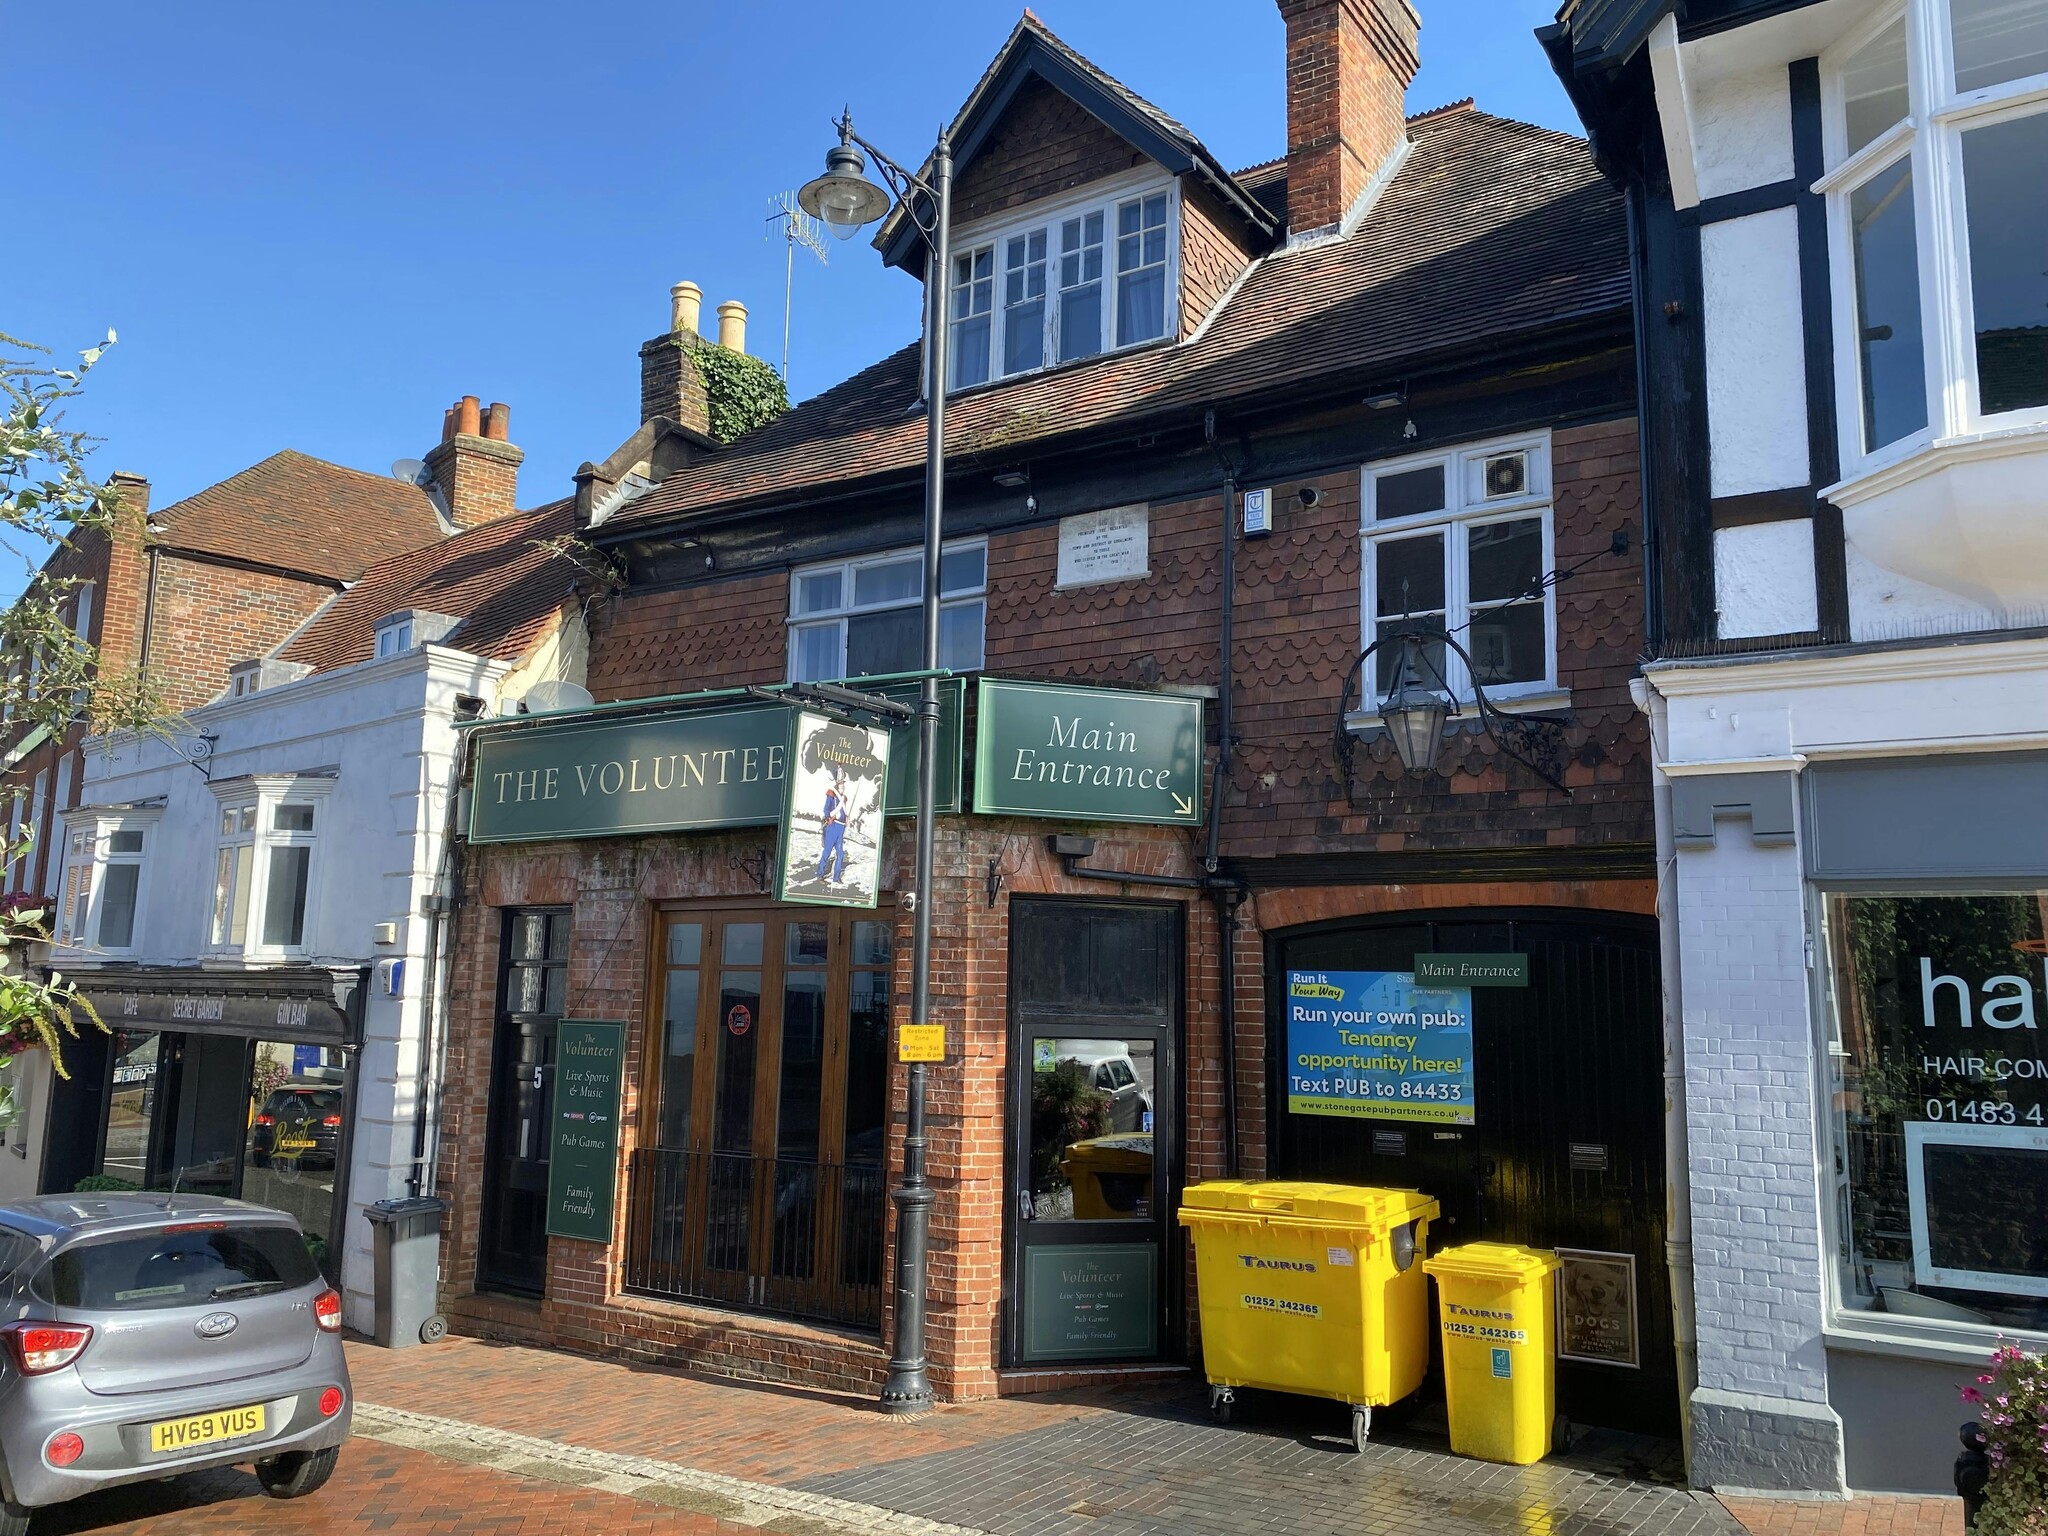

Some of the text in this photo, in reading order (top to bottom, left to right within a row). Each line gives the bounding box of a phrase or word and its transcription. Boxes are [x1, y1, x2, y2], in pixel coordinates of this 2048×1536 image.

[1046, 715, 1138, 753] Main
[838, 736, 852, 750] The
[816, 742, 872, 769] Volunteer
[493, 744, 785, 804] THE VOLUNTEE
[1010, 748, 1171, 790] Entrance
[1294, 973, 1328, 984] Run It
[1421, 963, 1521, 977] Main Entrance
[1294, 984, 1341, 1000] Your Way
[172, 998, 224, 1020] SECRET GARDEN
[276, 1003, 308, 1026] GIN BAR
[1293, 1006, 1466, 1030] Run your own pub:
[585, 1034, 596, 1043] The
[1338, 1029, 1417, 1052] Tenancy
[566, 1040, 614, 1056] Volunteer
[1297, 1053, 1462, 1076] opportunity here!
[1924, 1056, 1986, 1077] HAIR
[534, 1066, 542, 1089] 5
[566, 1070, 610, 1085] Live Sports
[570, 1084, 603, 1098] & Music
[1292, 1076, 1462, 1100] Text PUB to 84433
[1300, 1101, 1460, 1118] www.stonegatepubpartners.co.uk
[1926, 1098, 2044, 1126] 01483 4
[561, 1134, 605, 1149] Pub Games
[566, 1184, 593, 1202] Family
[562, 1200, 595, 1219] Friendly
[1086, 1262, 1099, 1271] The
[1062, 1270, 1122, 1283] Volunteer
[1060, 1292, 1072, 1300] Live
[1075, 1292, 1095, 1300] Sports
[1244, 1296, 1318, 1314] 01252 342365
[1248, 1305, 1315, 1318] www.taurus-waste.com
[1074, 1314, 1087, 1323] Pub
[1575, 1314, 1620, 1330] DOGS
[1066, 1330, 1117, 1341] Family Friendly
[1444, 1322, 1524, 1339] 01252 342365
[1447, 1332, 1522, 1344] www.taurus-waste.com
[161, 1418, 214, 1446] HV69
[220, 1410, 256, 1434] VUS
